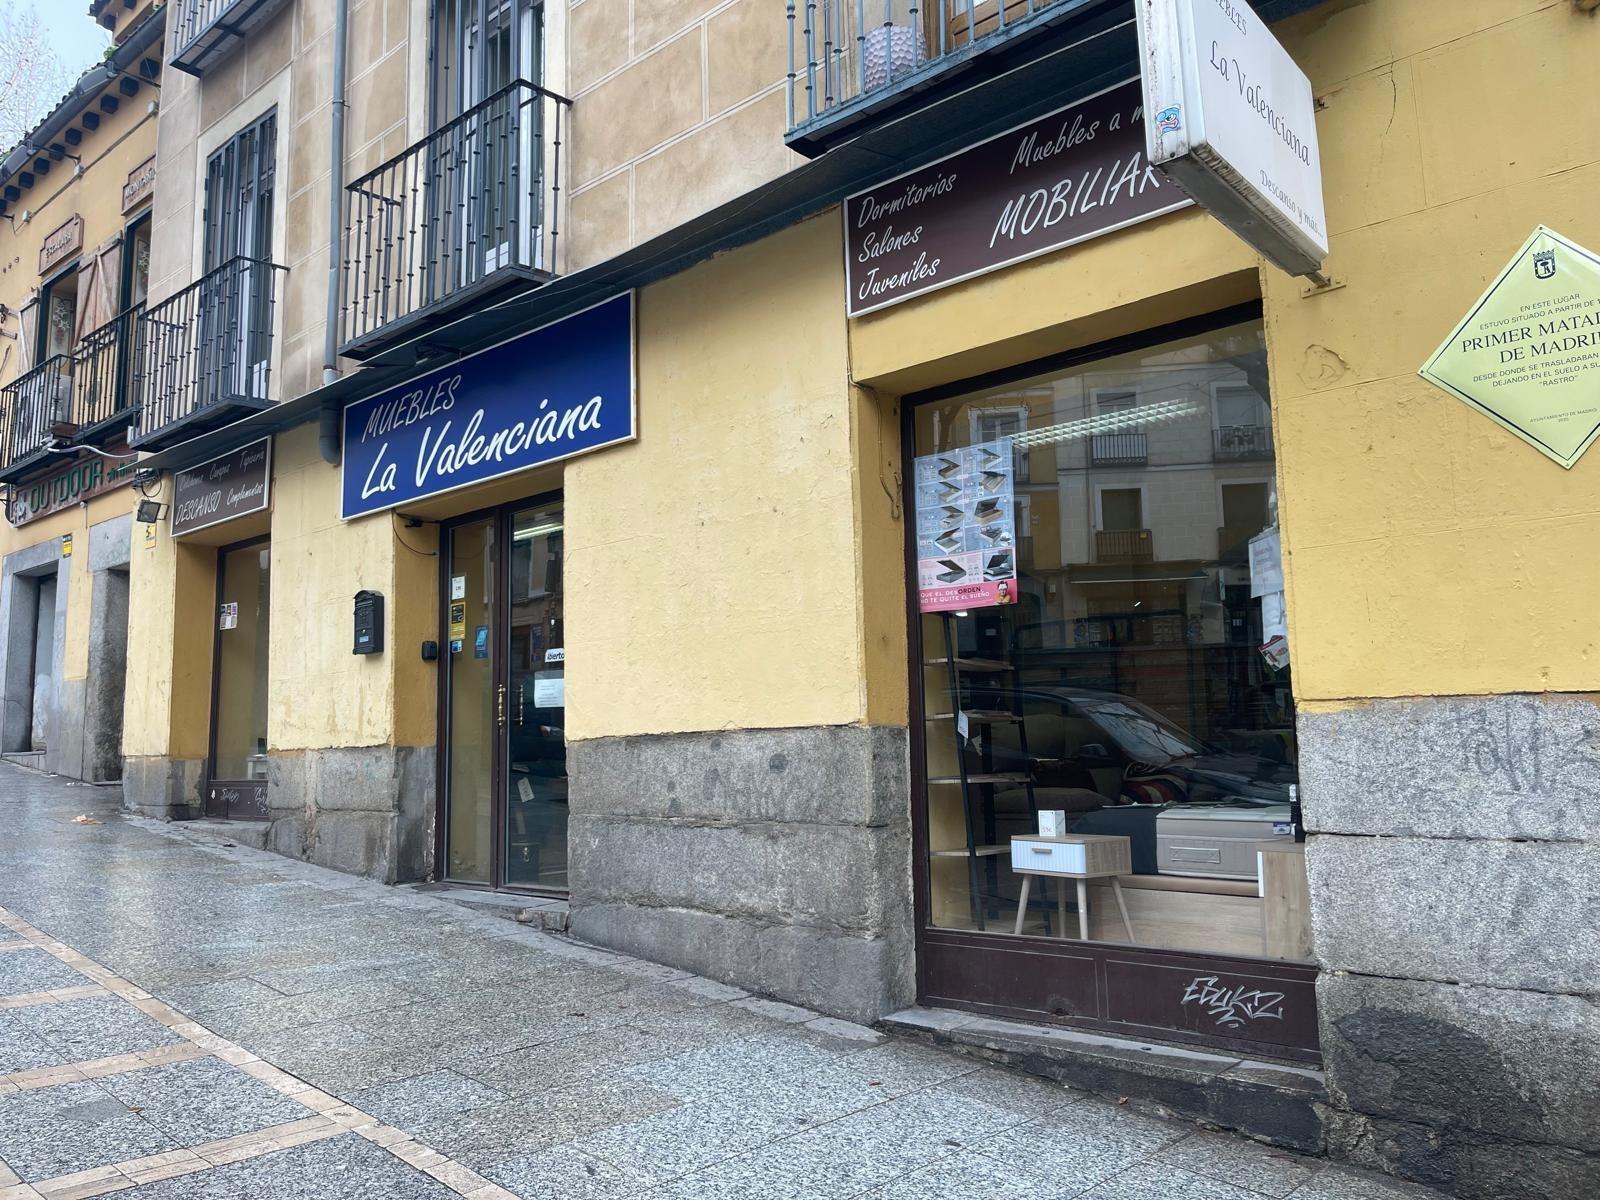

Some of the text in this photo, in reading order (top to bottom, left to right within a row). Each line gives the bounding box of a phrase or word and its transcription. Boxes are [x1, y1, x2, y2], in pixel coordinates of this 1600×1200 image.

[1209, 40, 1311, 167] La Valenciana
[1009, 113, 1101, 175] Muebles
[1108, 111, 1122, 131] a
[857, 171, 958, 229] Dormitorios
[1259, 169, 1296, 213] Descanso
[1297, 205, 1304, 225] y
[858, 224, 924, 264] Salones
[858, 251, 941, 300] Juveniles
[1479, 318, 1510, 331] ESTUVO
[1511, 311, 1546, 323] SITUADO
[1555, 302, 1583, 314] PARTIR
[1583, 299, 1595, 308] DE
[1520, 293, 1581, 312] EN ESTE LUGAR
[1462, 326, 1533, 353] PRIMER
[1499, 331, 1600, 364] DE MADRI
[1473, 352, 1600, 383] DESDE DONDE SE TRASLADABAN
[1492, 375, 1529, 388] DEJANDO
[1531, 372, 1542, 381] EN
[1543, 370, 1552, 378] EL
[1554, 365, 1581, 376] SUELO
[1582, 363, 1589, 371] A
[361, 374, 462, 443] MUEBLES
[361, 396, 602, 500] La Valenciana
[29, 458, 105, 514] OUTDOOR
[175, 489, 222, 526] DESCANSO
